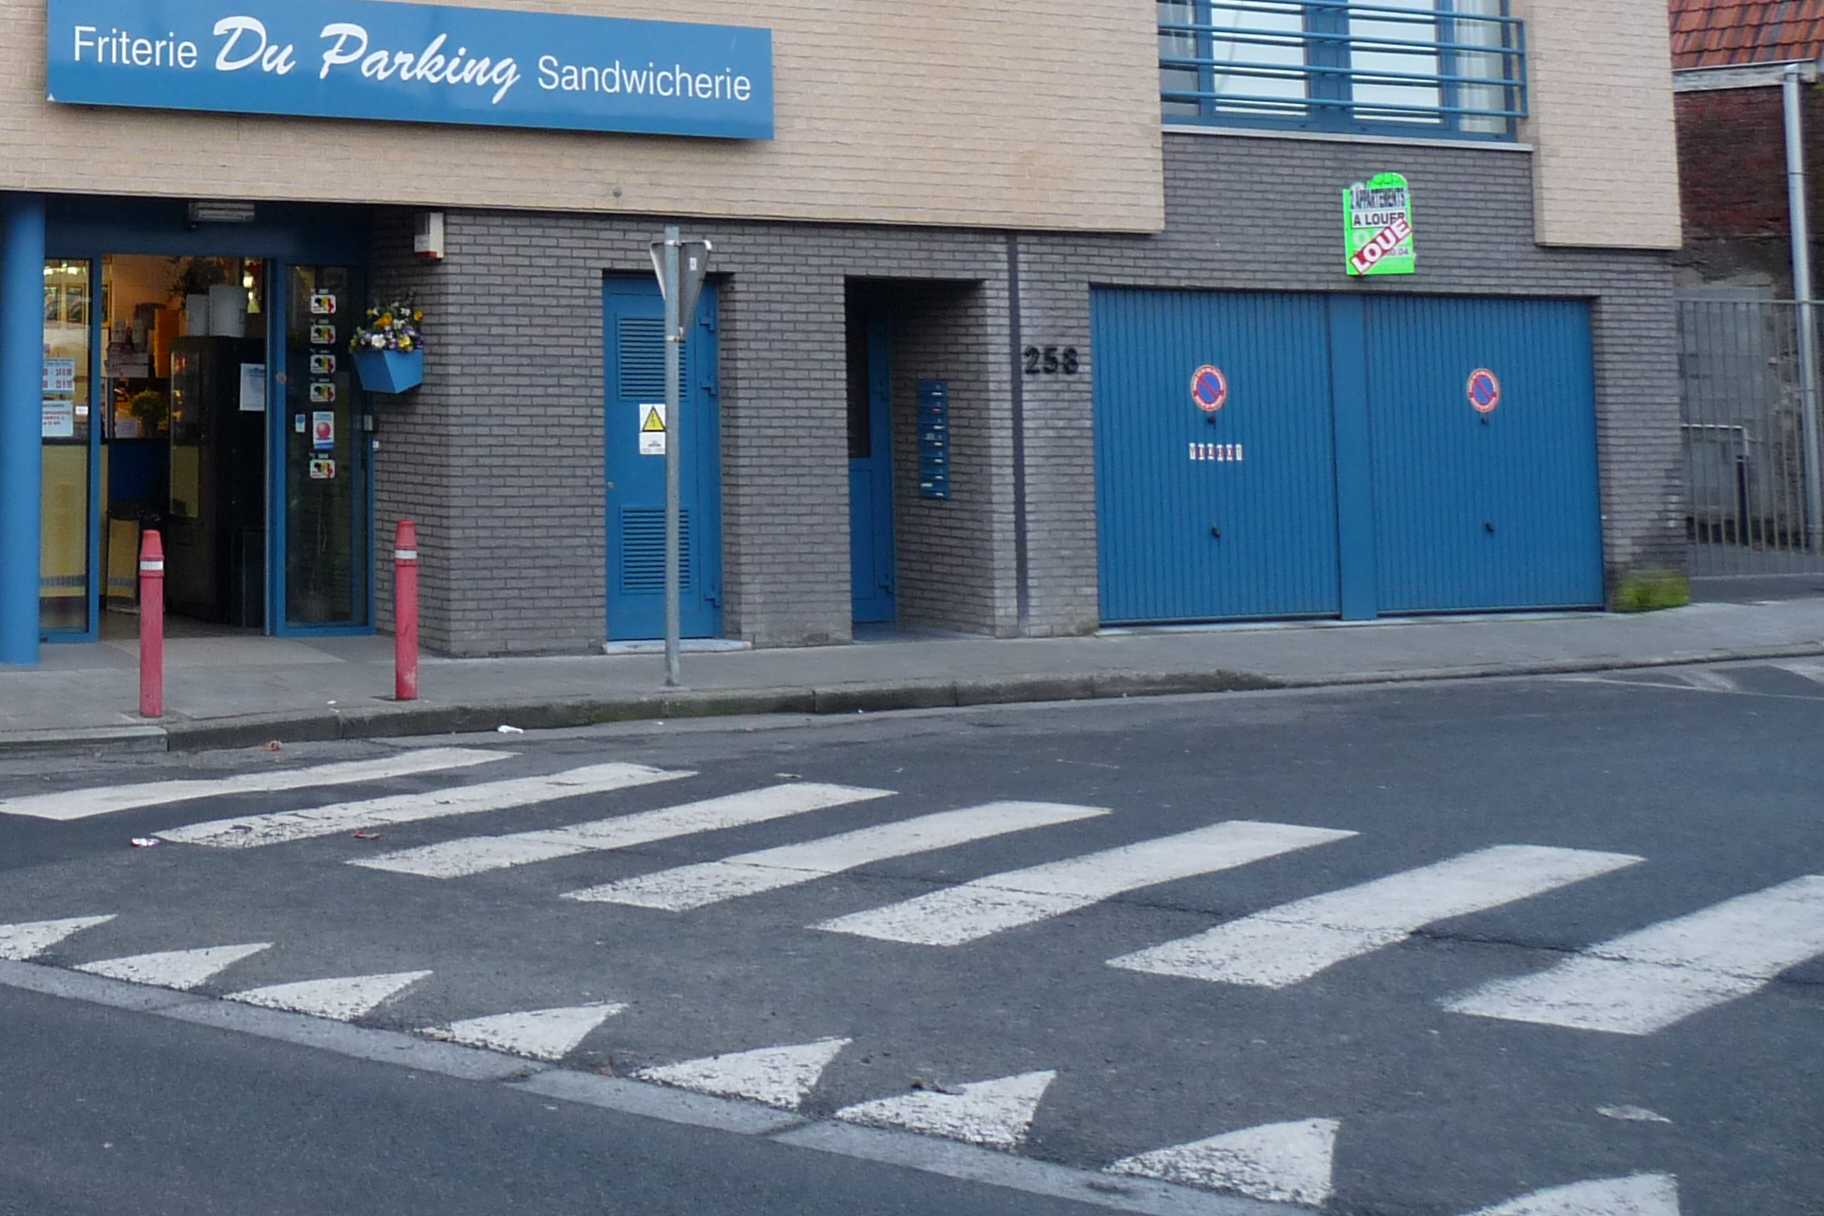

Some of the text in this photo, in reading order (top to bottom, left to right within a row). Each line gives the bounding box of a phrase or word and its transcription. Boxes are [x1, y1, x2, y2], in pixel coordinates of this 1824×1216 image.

[74, 15, 752, 104] Friterie Du Parking Sandwicherie
[1353, 214, 1361, 226] A
[1025, 347, 1078, 374] 258
